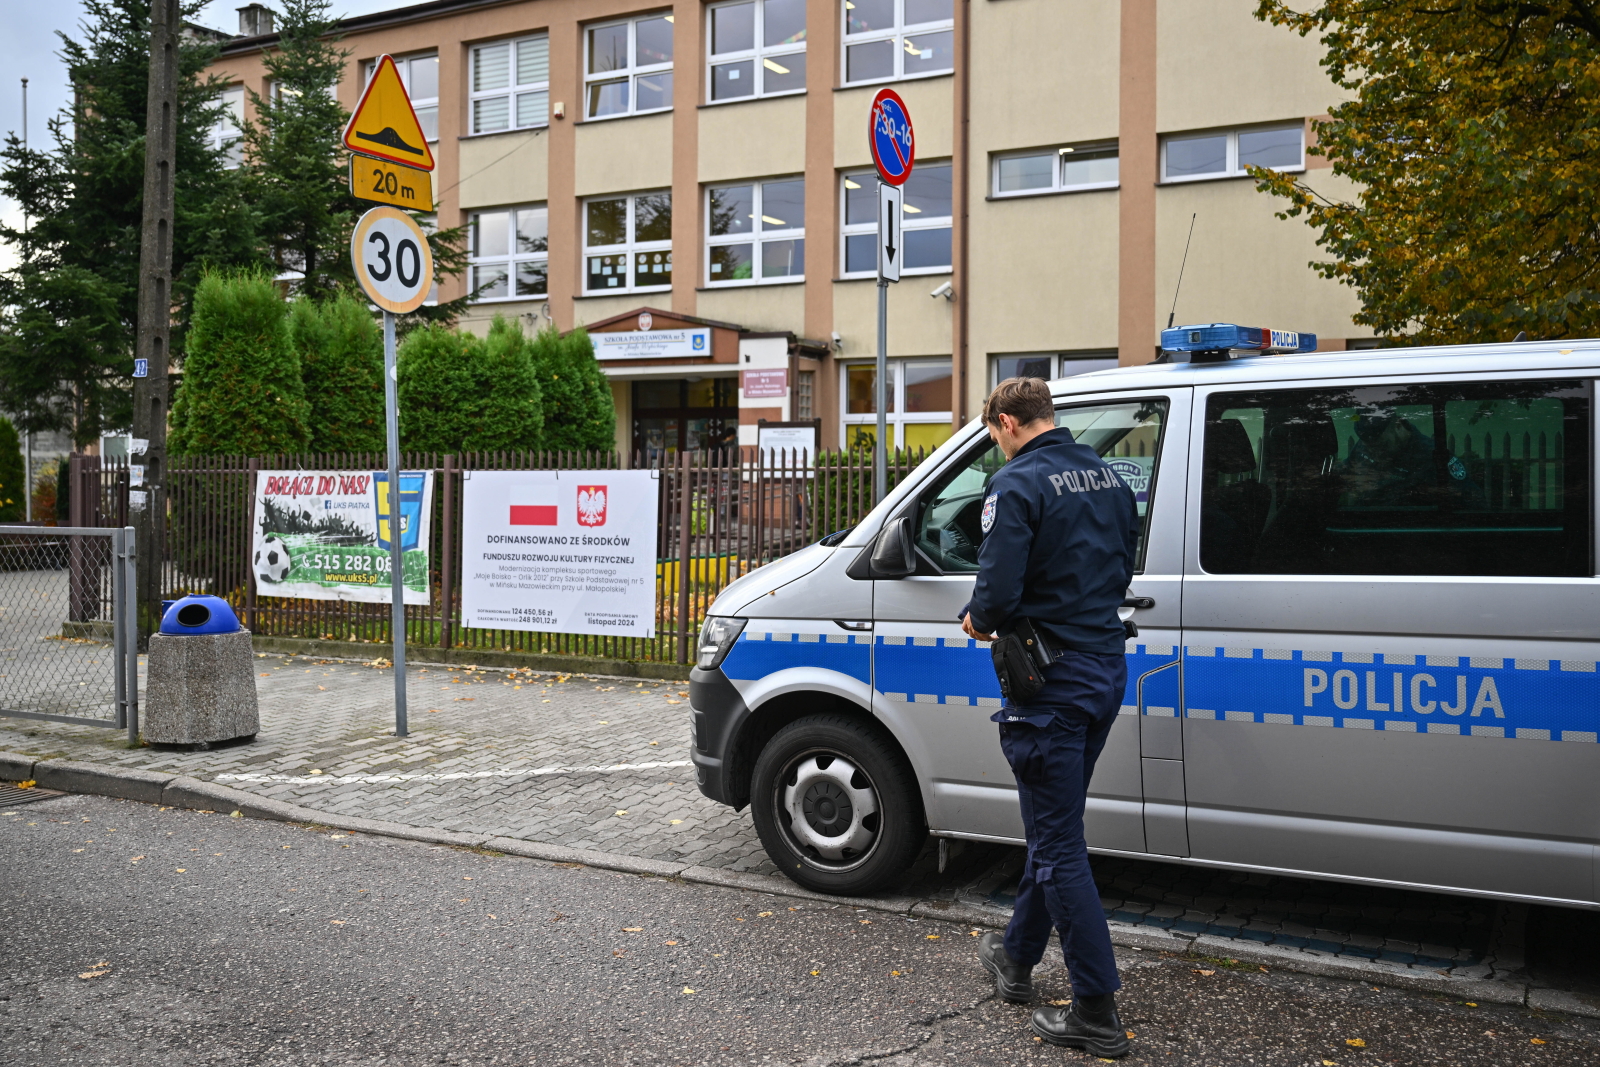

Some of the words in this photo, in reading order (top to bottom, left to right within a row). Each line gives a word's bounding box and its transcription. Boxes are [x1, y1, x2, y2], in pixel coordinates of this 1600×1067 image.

[372, 169, 398, 196] 20
[401, 184, 415, 200] m
[367, 231, 421, 288] 30
[629, 334, 673, 342] PODSTAWOWA
[681, 332, 686, 340] 5
[1271, 331, 1298, 348] POLICJA
[316, 475, 336, 495] DO
[337, 475, 371, 495] NAS!
[1048, 467, 1121, 496] POLICJA
[487, 535, 568, 546] DOFINANSOWANO
[569, 536, 580, 545] ZE
[582, 534, 630, 546] ŚRODKÓW
[314, 554, 340, 570] 515
[345, 555, 371, 571] 282
[375, 556, 392, 572] 08
[483, 553, 520, 561] FUNDUSZU
[522, 554, 559, 562] ROZWOJU
[560, 555, 593, 563] KULTURY
[594, 556, 635, 564] FIZYCZNEJ
[499, 565, 540, 574] Modernizacja
[542, 566, 577, 575] kompleksu
[578, 567, 617, 577] sportowego
[325, 573, 377, 585] www.uks5.pl
[550, 575, 563, 583] przy
[586, 576, 630, 586] Podstawowej
[518, 582, 560, 590] Mazowieckim
[561, 584, 575, 592] przy
[586, 585, 627, 595] Małopolskiej
[588, 617, 617, 627] listopad
[1303, 667, 1506, 719] POLICJA
